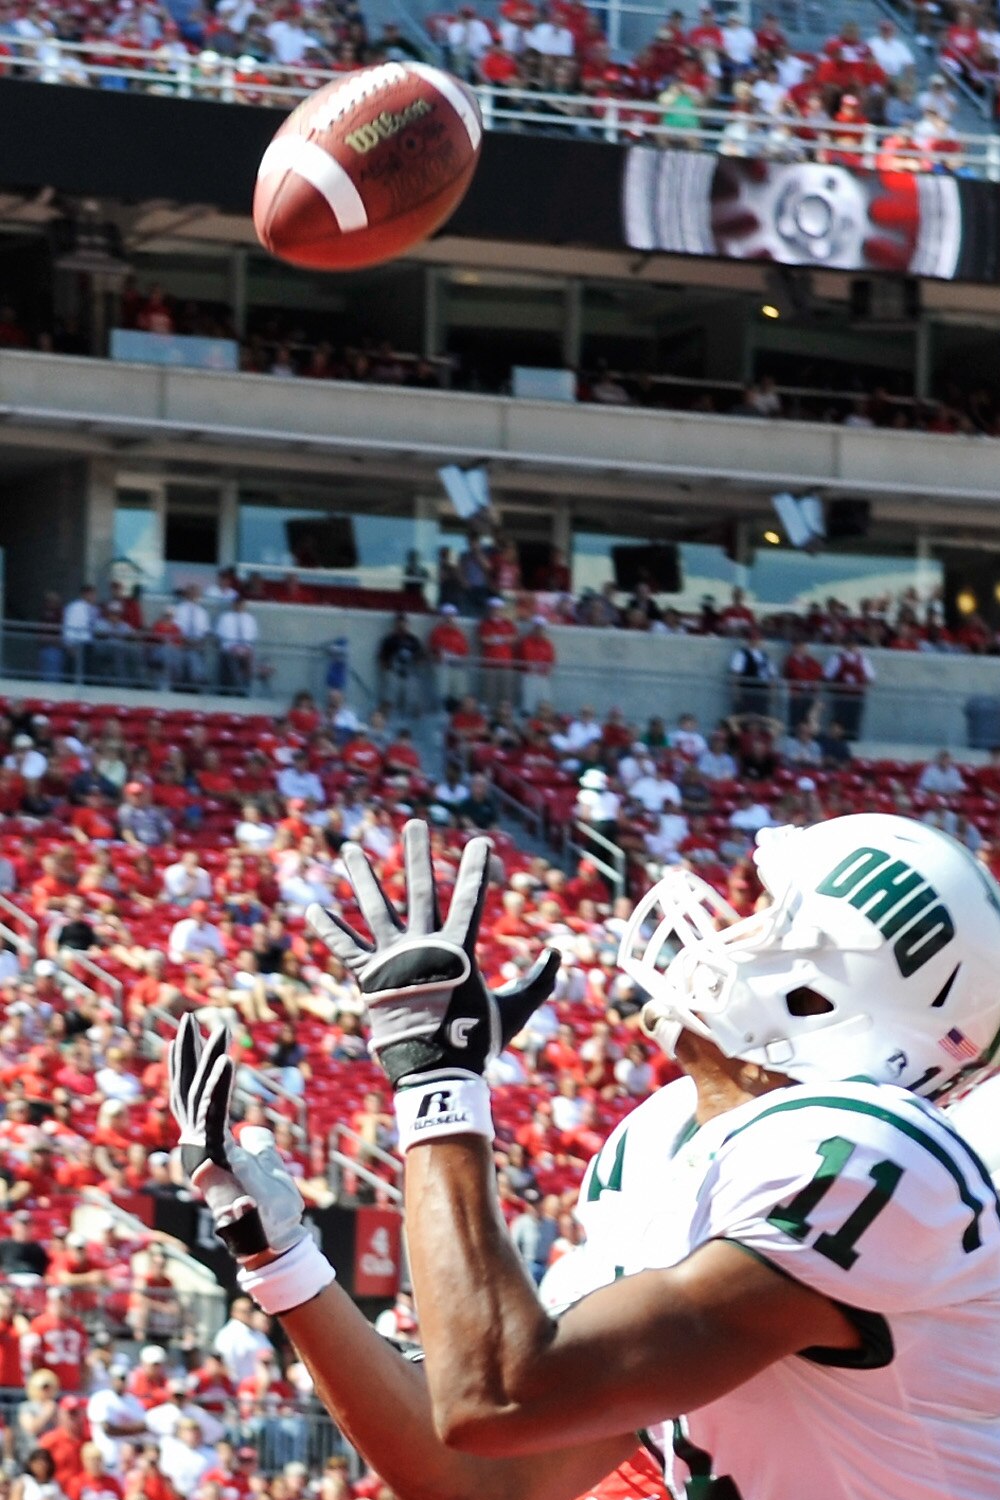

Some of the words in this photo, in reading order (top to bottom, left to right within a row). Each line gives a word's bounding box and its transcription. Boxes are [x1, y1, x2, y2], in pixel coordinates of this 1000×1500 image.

[344, 98, 435, 154] Wilson
[814, 846, 956, 979] OHIO
[412, 1112, 468, 1131] USSELL
[765, 1135, 908, 1272] 11
